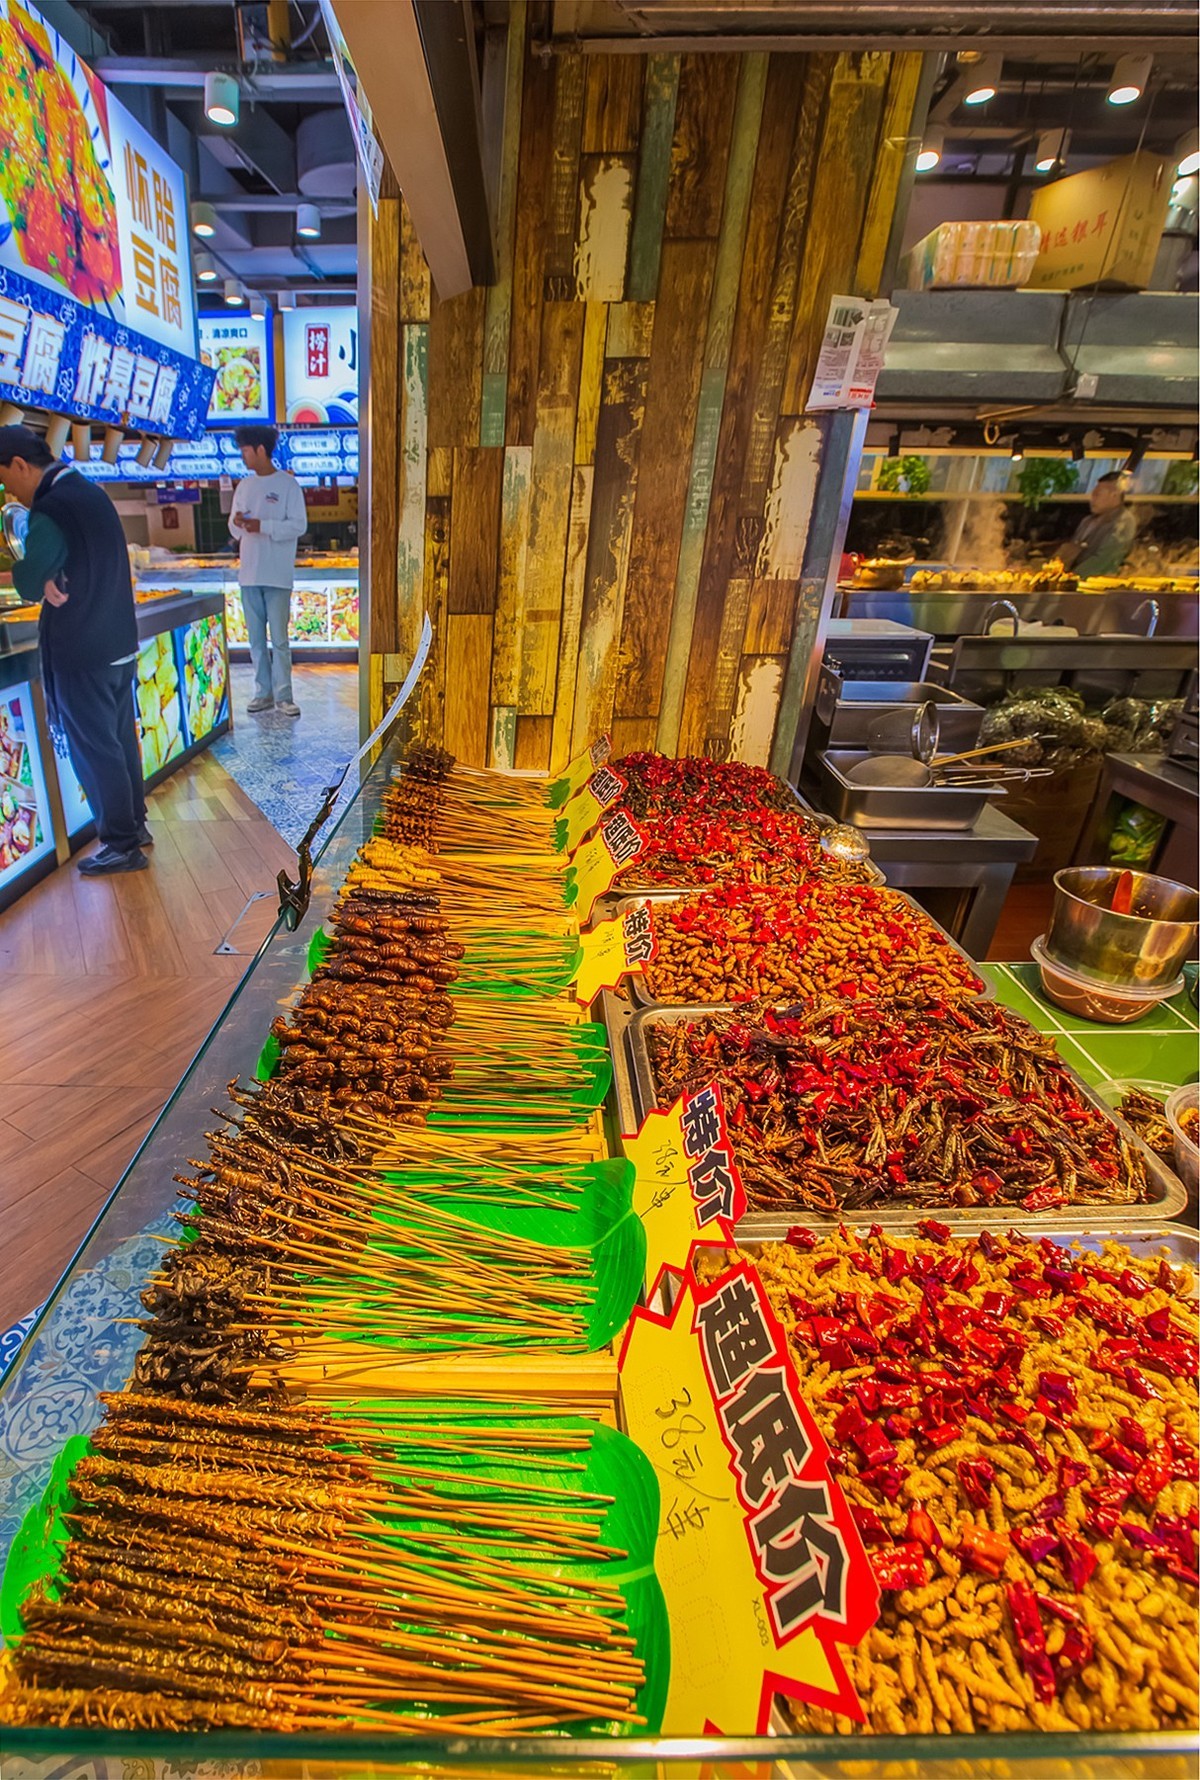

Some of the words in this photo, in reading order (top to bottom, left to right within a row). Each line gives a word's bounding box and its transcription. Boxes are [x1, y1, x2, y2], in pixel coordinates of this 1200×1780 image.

[124, 139, 177, 255] 怀胎
[131, 231, 183, 331] 豆腐
[74, 331, 178, 425] 炸臭豆腐
[308, 330, 327, 375] 捞汁
[602, 811, 643, 866] 超低价
[625, 907, 653, 966] 特价
[682, 1088, 733, 1224] 特价
[699, 1278, 846, 1635] 超低价
[752, 1597, 769, 1647] XL-003
